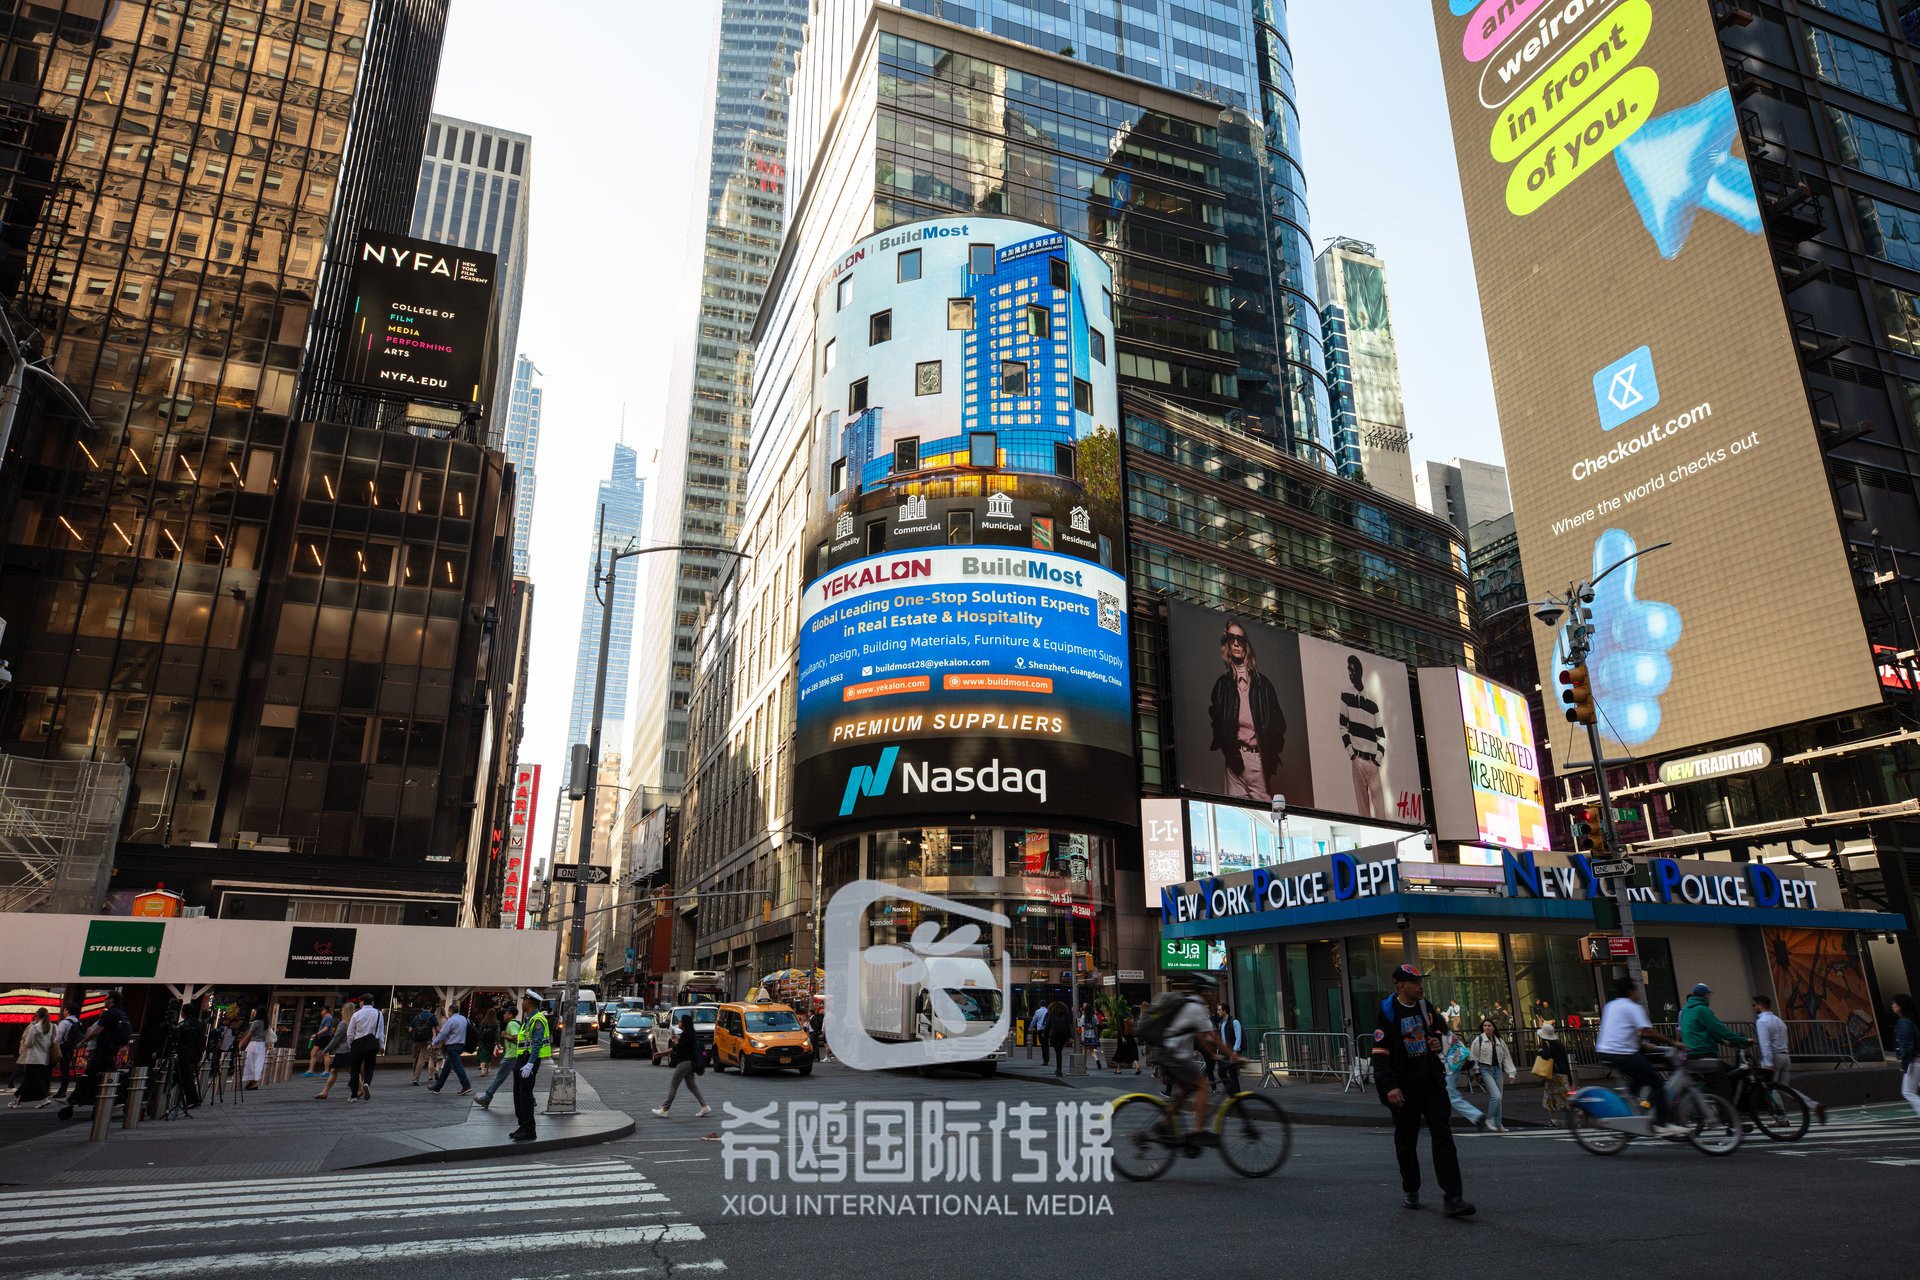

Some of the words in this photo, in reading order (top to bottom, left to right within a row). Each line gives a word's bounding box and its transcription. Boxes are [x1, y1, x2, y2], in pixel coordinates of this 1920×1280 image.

[1507, 106, 1537, 142] in
[1542, 23, 1628, 112] front
[1527, 146, 1557, 192] of
[1564, 98, 1639, 170] you.
[879, 224, 969, 251] BuildMost
[362, 242, 450, 277] NYFA
[460, 275, 488, 284] ACADEMY
[390, 313, 414, 324] FILM
[391, 302, 439, 317] COLLEGE
[441, 311, 455, 319] OF
[388, 325, 420, 336] MEDIA
[384, 347, 410, 358] ARTS
[386, 335, 453, 353] PERFORMING
[380, 370, 448, 388] NYFA.EDU
[1571, 401, 1713, 481] Checkout.com
[1551, 507, 1595, 537] Where
[1597, 496, 1621, 516] the
[1624, 476, 1665, 503] world
[1668, 448, 1727, 484] checks
[1730, 430, 1760, 455] out
[893, 523, 941, 535] Commercial
[981, 521, 1022, 531] Municipal
[831, 536, 861, 554] Hospitality
[1061, 532, 1097, 550] Residential
[822, 558, 931, 601] YEKALON
[962, 556, 1083, 588] BuildMost
[811, 611, 838, 633] Global
[840, 599, 890, 620] Leading
[894, 591, 967, 607] One-Stop
[972, 590, 1037, 606] Solution
[1040, 595, 1090, 616] Experts
[843, 624, 855, 638] in
[857, 616, 887, 634] Real
[891, 612, 937, 628] Estate
[941, 611, 953, 623] &
[957, 609, 1043, 628] Hospitality
[829, 648, 861, 665] Design,
[863, 640, 907, 655] Building
[911, 633, 970, 648] Materials,
[974, 634, 1030, 647] Furniture
[1033, 637, 1041, 649] &
[1044, 639, 1098, 659] Equipment
[1098, 650, 1123, 671] Supply
[875, 658, 990, 673] buildmost28@yekalon.com
[1028, 660, 1069, 674] Shenzhen,
[1070, 666, 1108, 683] Guangdong,
[1108, 675, 1122, 687] China
[856, 679, 925, 696] www.yekalon.com
[962, 677, 1048, 689] www.buildmost.com
[832, 714, 923, 742] PREMIUM
[933, 713, 1063, 733] SUPPLIERS
[902, 758, 1047, 804] Nasdaq
[513, 772, 530, 825] PARK
[1397, 790, 1421, 822] H&M
[561, 869, 577, 878] ONE
[1614, 863, 1628, 872] WAY
[504, 857, 521, 912] PARK
[1502, 848, 1576, 899] NEW
[1653, 858, 1749, 907] POLICE
[1750, 863, 1817, 909] DEPT
[1161, 886, 1199, 925] NEW
[1199, 878, 1250, 919] YORK
[1253, 868, 1325, 911] POLICE
[1332, 853, 1400, 900] DEPT
[892, 906, 911, 914] Nasdaq
[1026, 906, 1047, 914] Nasdaq
[89, 944, 143, 953] STARBUCKS
[1167, 942, 1200, 959] suja
